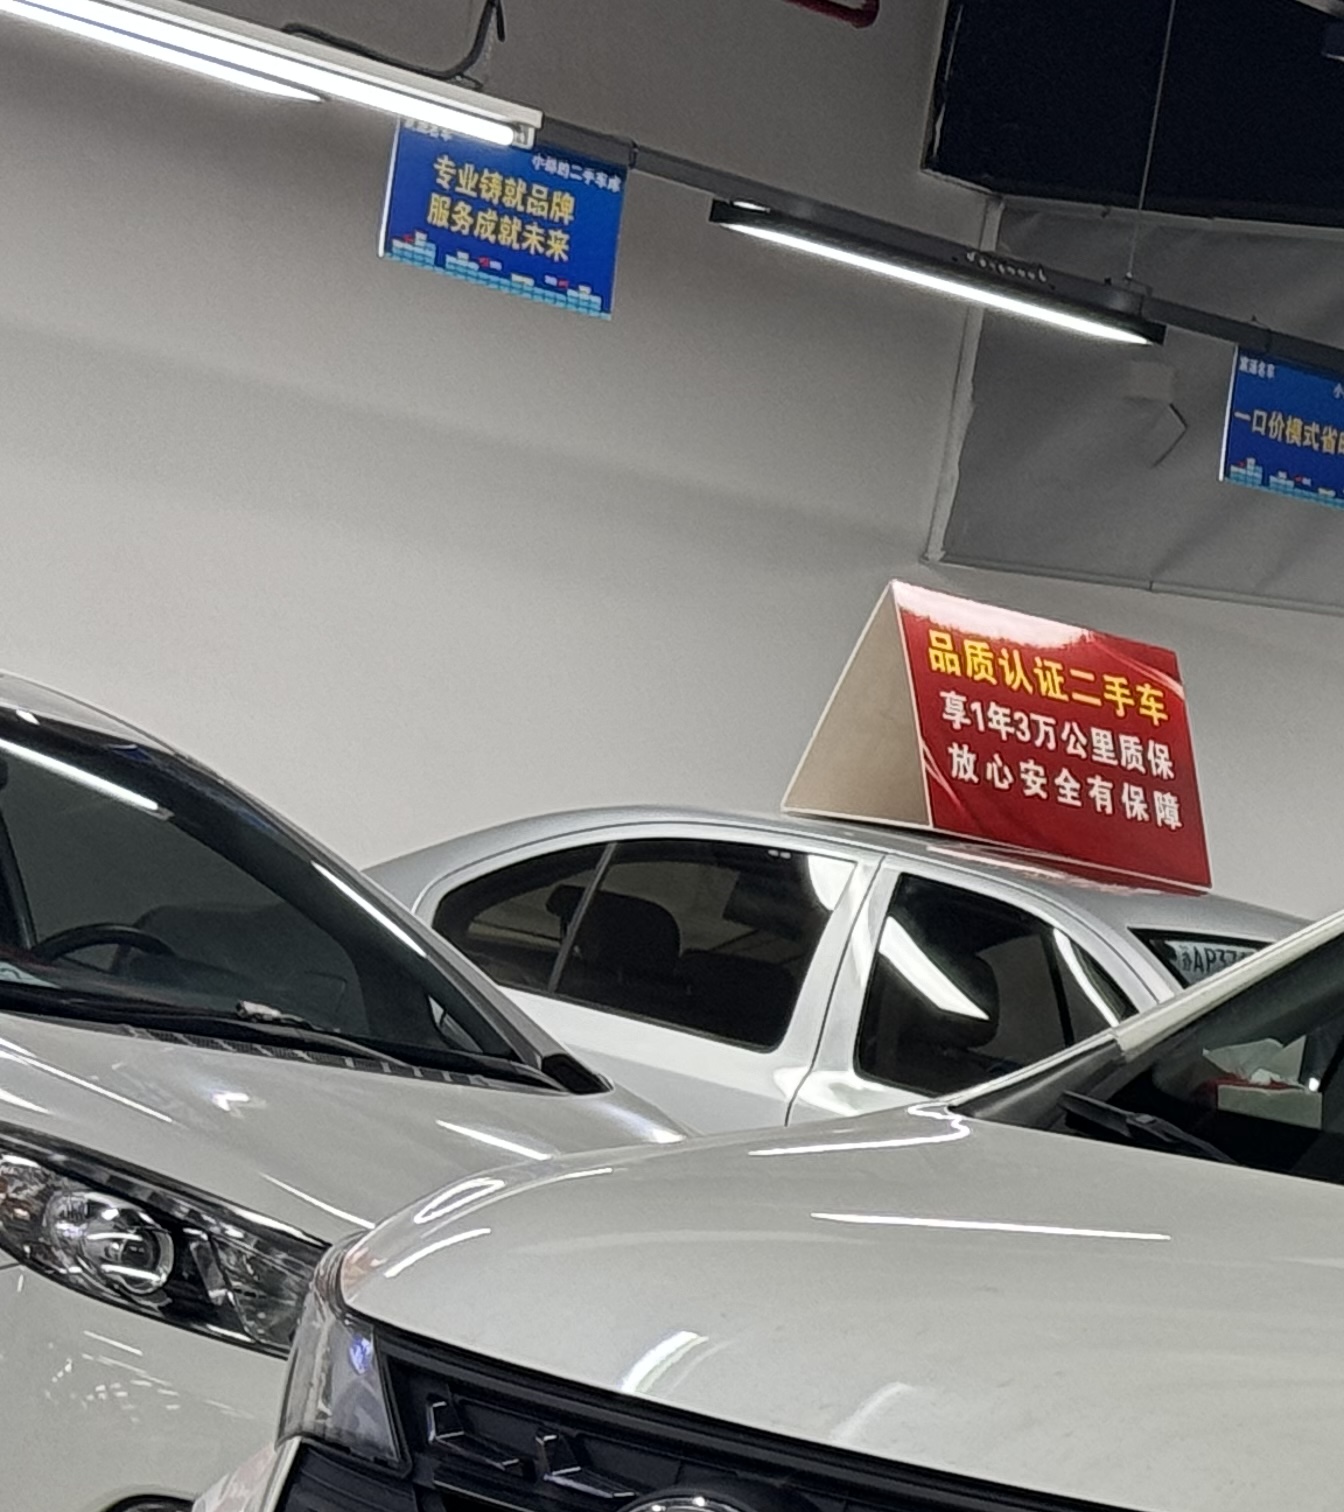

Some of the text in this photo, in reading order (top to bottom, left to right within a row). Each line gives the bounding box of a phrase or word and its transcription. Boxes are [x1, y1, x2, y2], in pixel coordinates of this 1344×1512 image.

[426, 192, 570, 263] 服务成就未来
[433, 154, 576, 225] 专业铸就品牌
[928, 629, 1169, 727] 品质认证二手车
[940, 690, 1176, 782] 享1年3万公里质保
[948, 742, 1183, 832] 放心安全有保障
